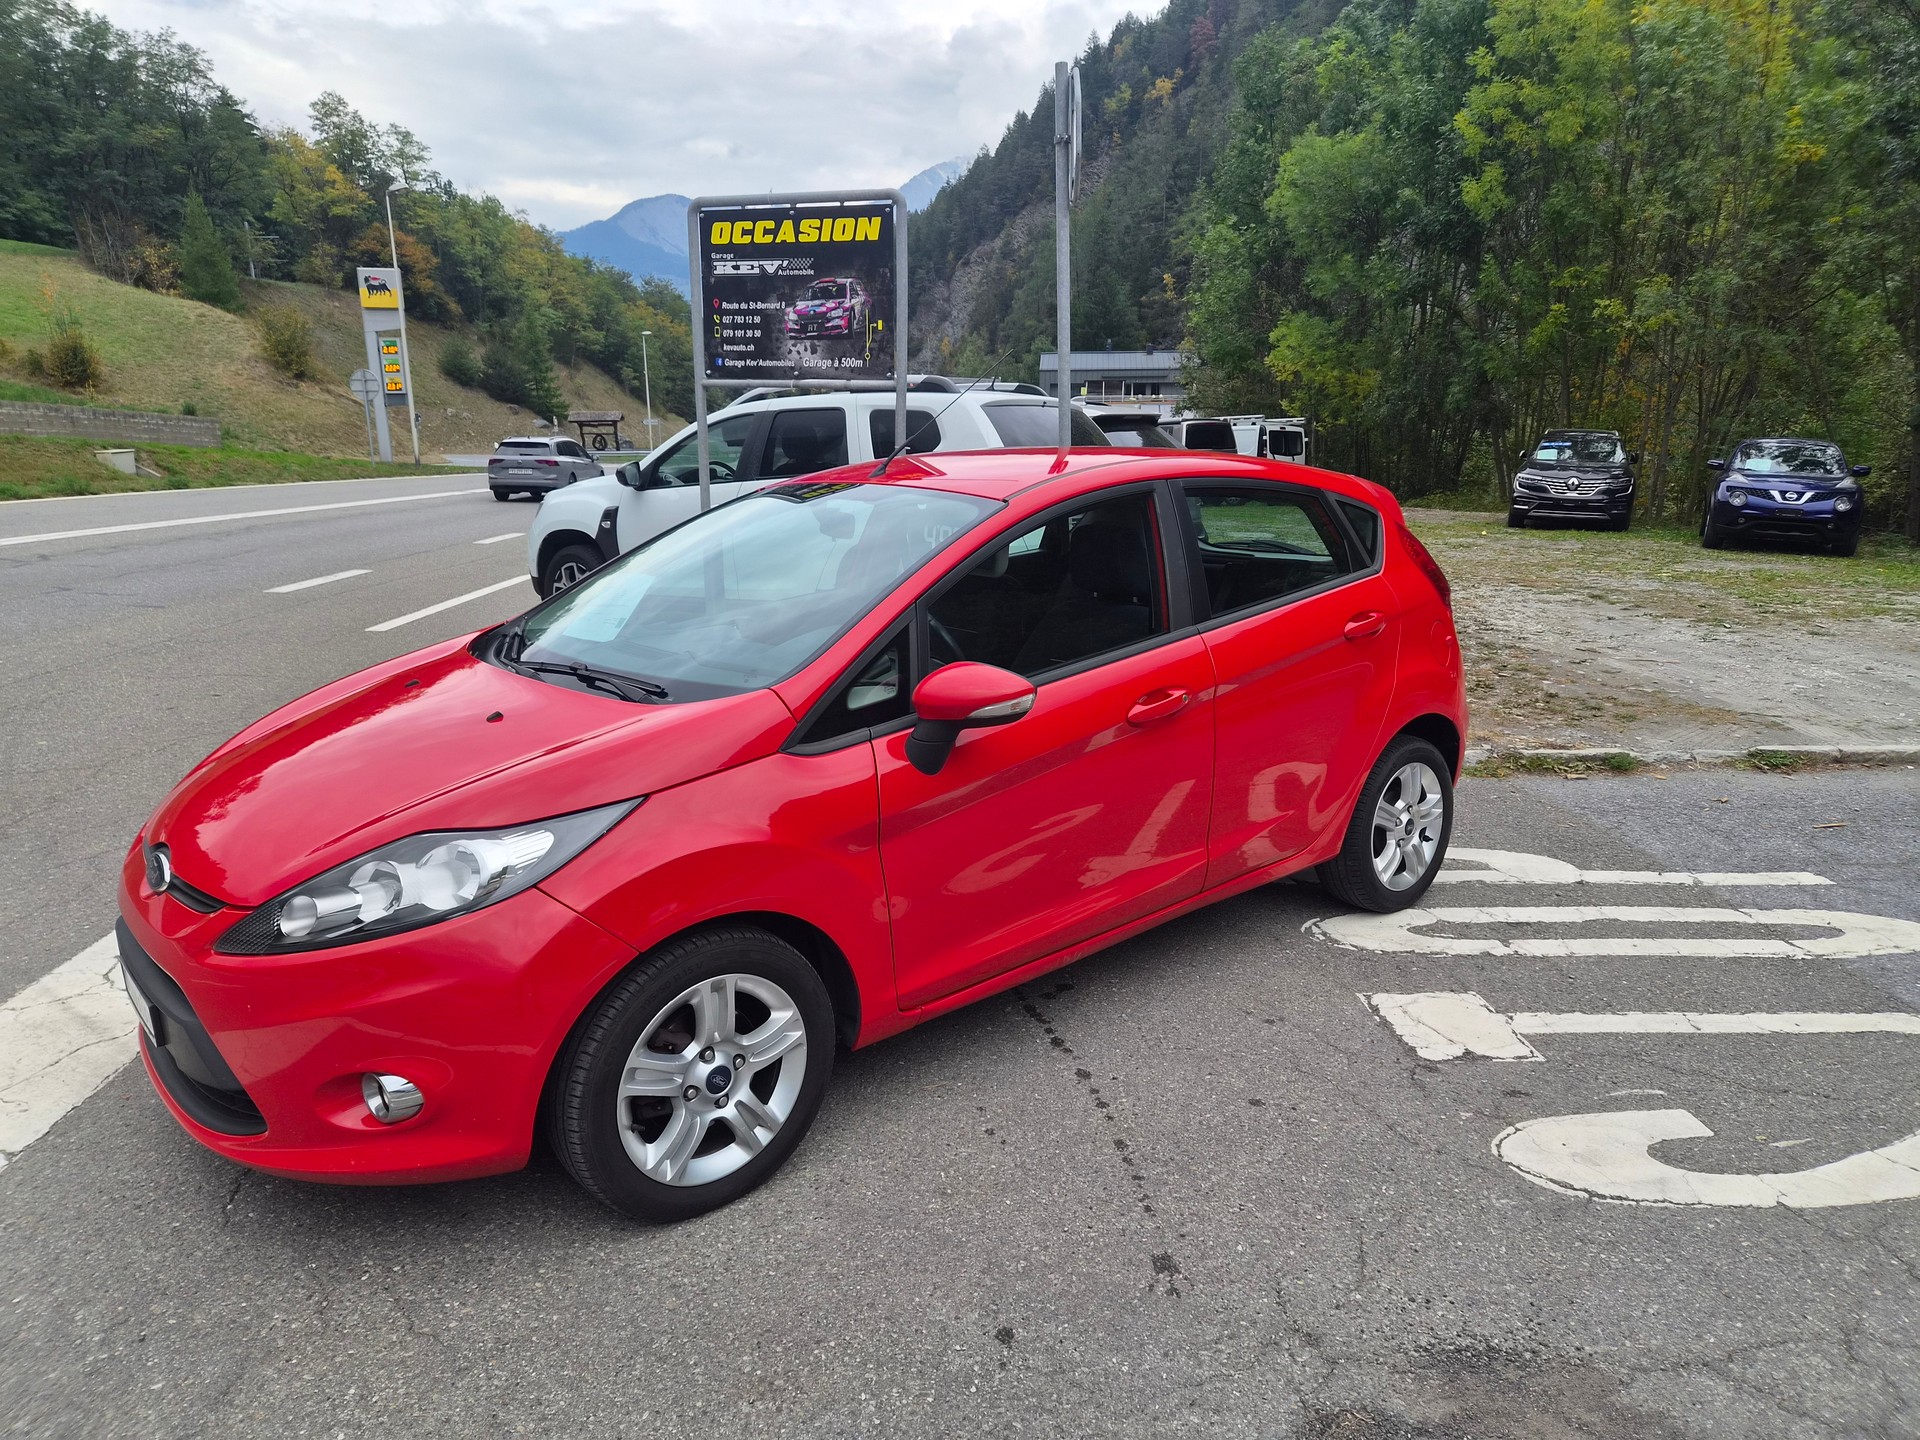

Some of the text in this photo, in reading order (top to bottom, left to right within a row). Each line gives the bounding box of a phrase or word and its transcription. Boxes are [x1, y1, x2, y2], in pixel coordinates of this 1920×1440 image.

[711, 217, 882, 245] OCCASION
[711, 253, 734, 261] Garage
[778, 269, 815, 277] Automobile
[722, 301, 786, 310] Route du St-Bernard 8
[722, 315, 761, 324] 027 783 12 50
[722, 329, 762, 338] 079 101 30 50
[723, 343, 755, 352] kevauto.ch
[724, 358, 795, 369] Garage Kev'Automobiles
[803, 357, 863, 370] Garage à 500m
